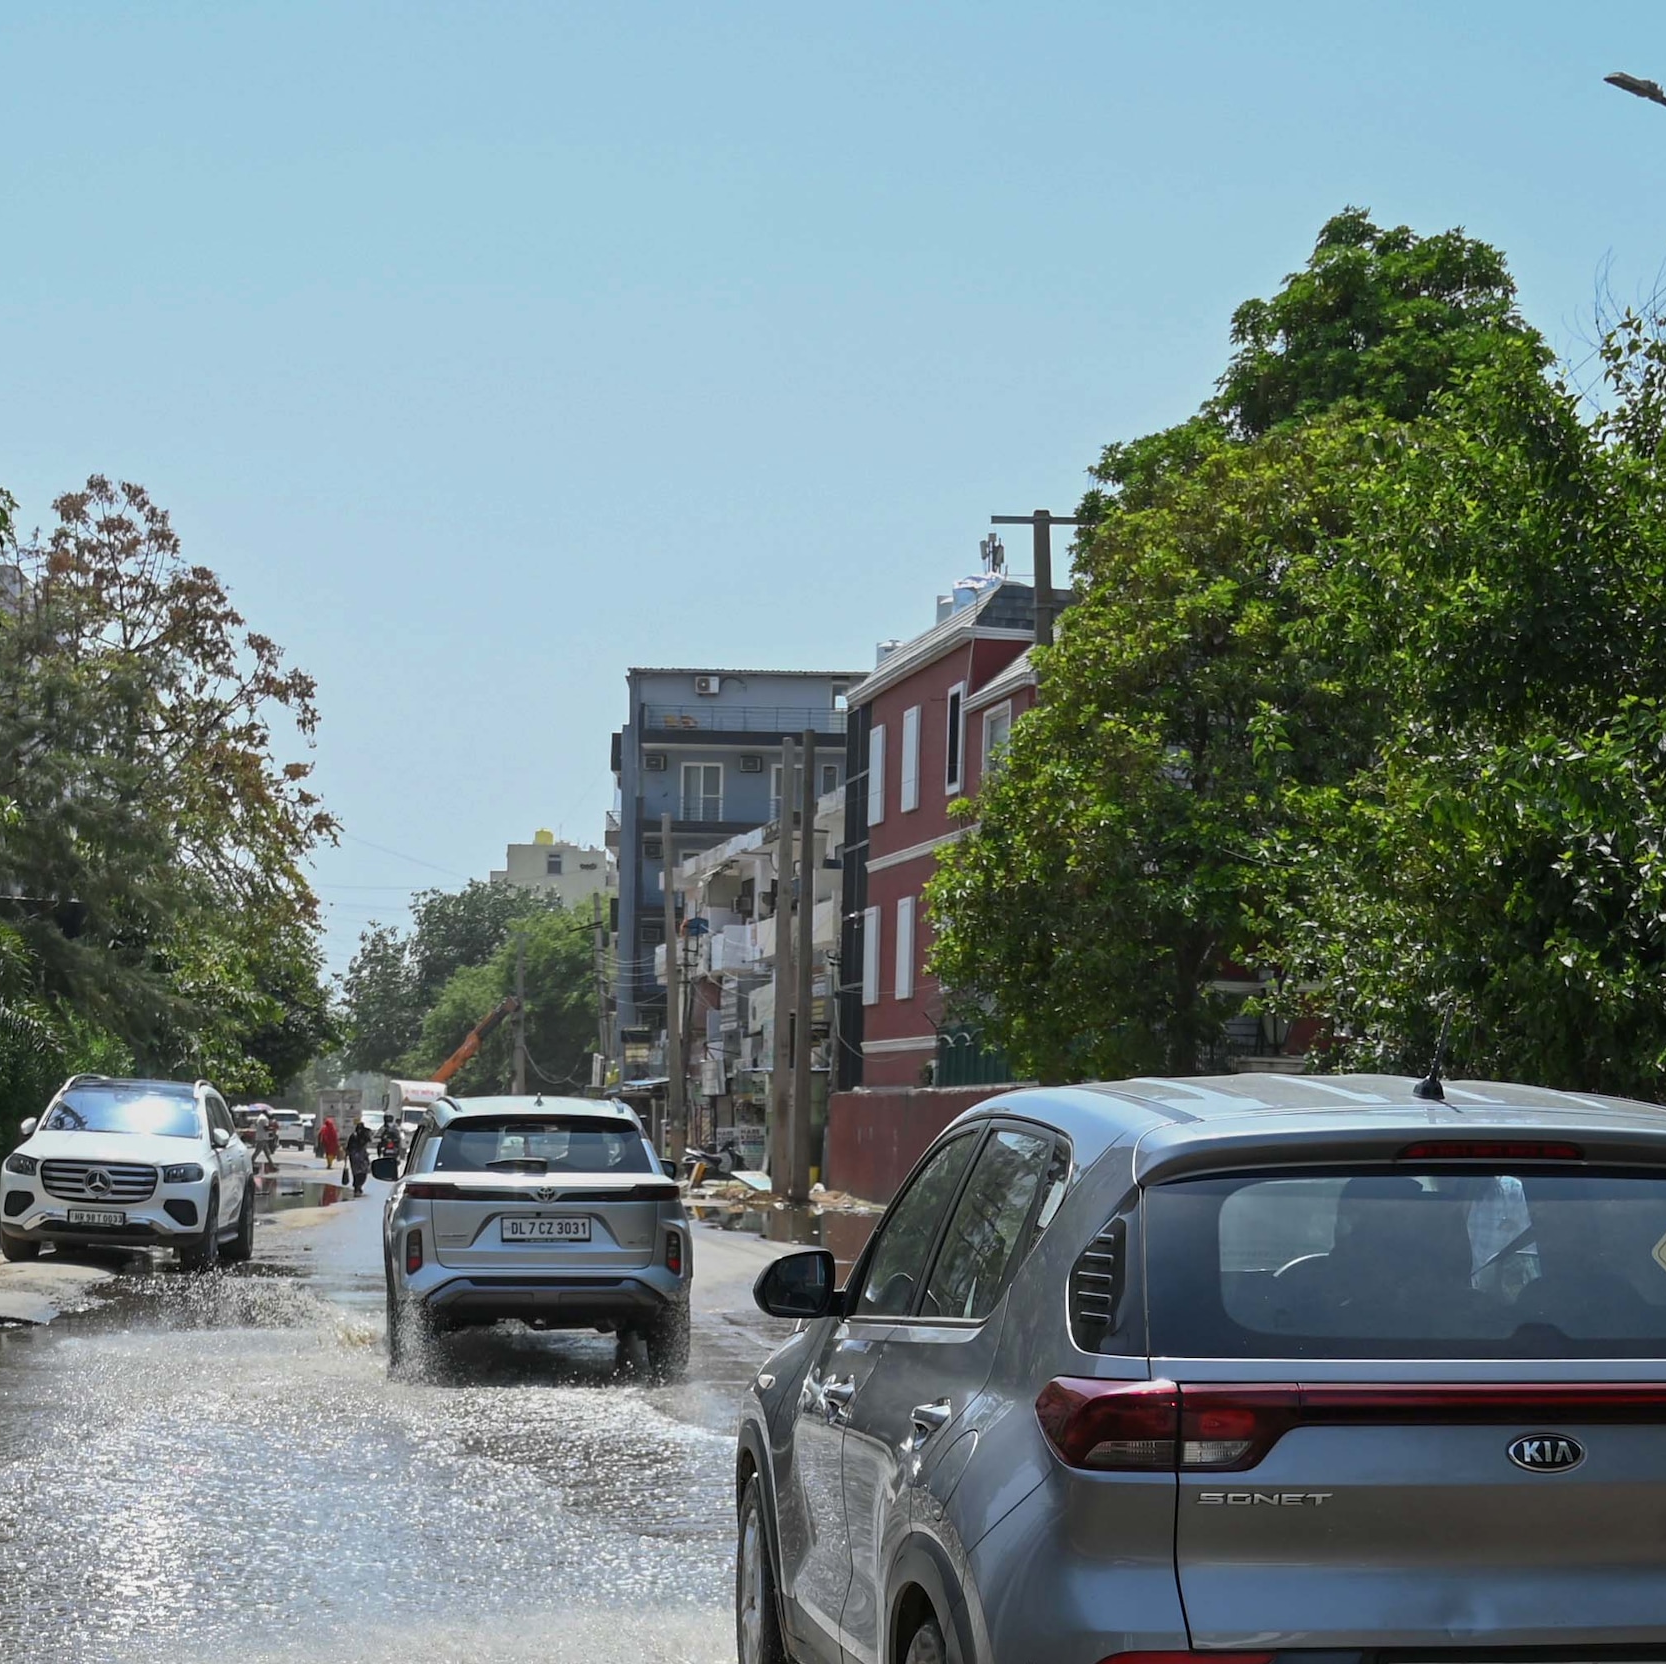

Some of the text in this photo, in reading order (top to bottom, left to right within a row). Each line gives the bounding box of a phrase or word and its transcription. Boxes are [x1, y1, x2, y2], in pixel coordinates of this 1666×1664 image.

[511, 1222, 587, 1235] DL 7 CZ 3031
[1523, 1440, 1574, 1462] KIA
[1196, 1492, 1333, 1506] SONET
